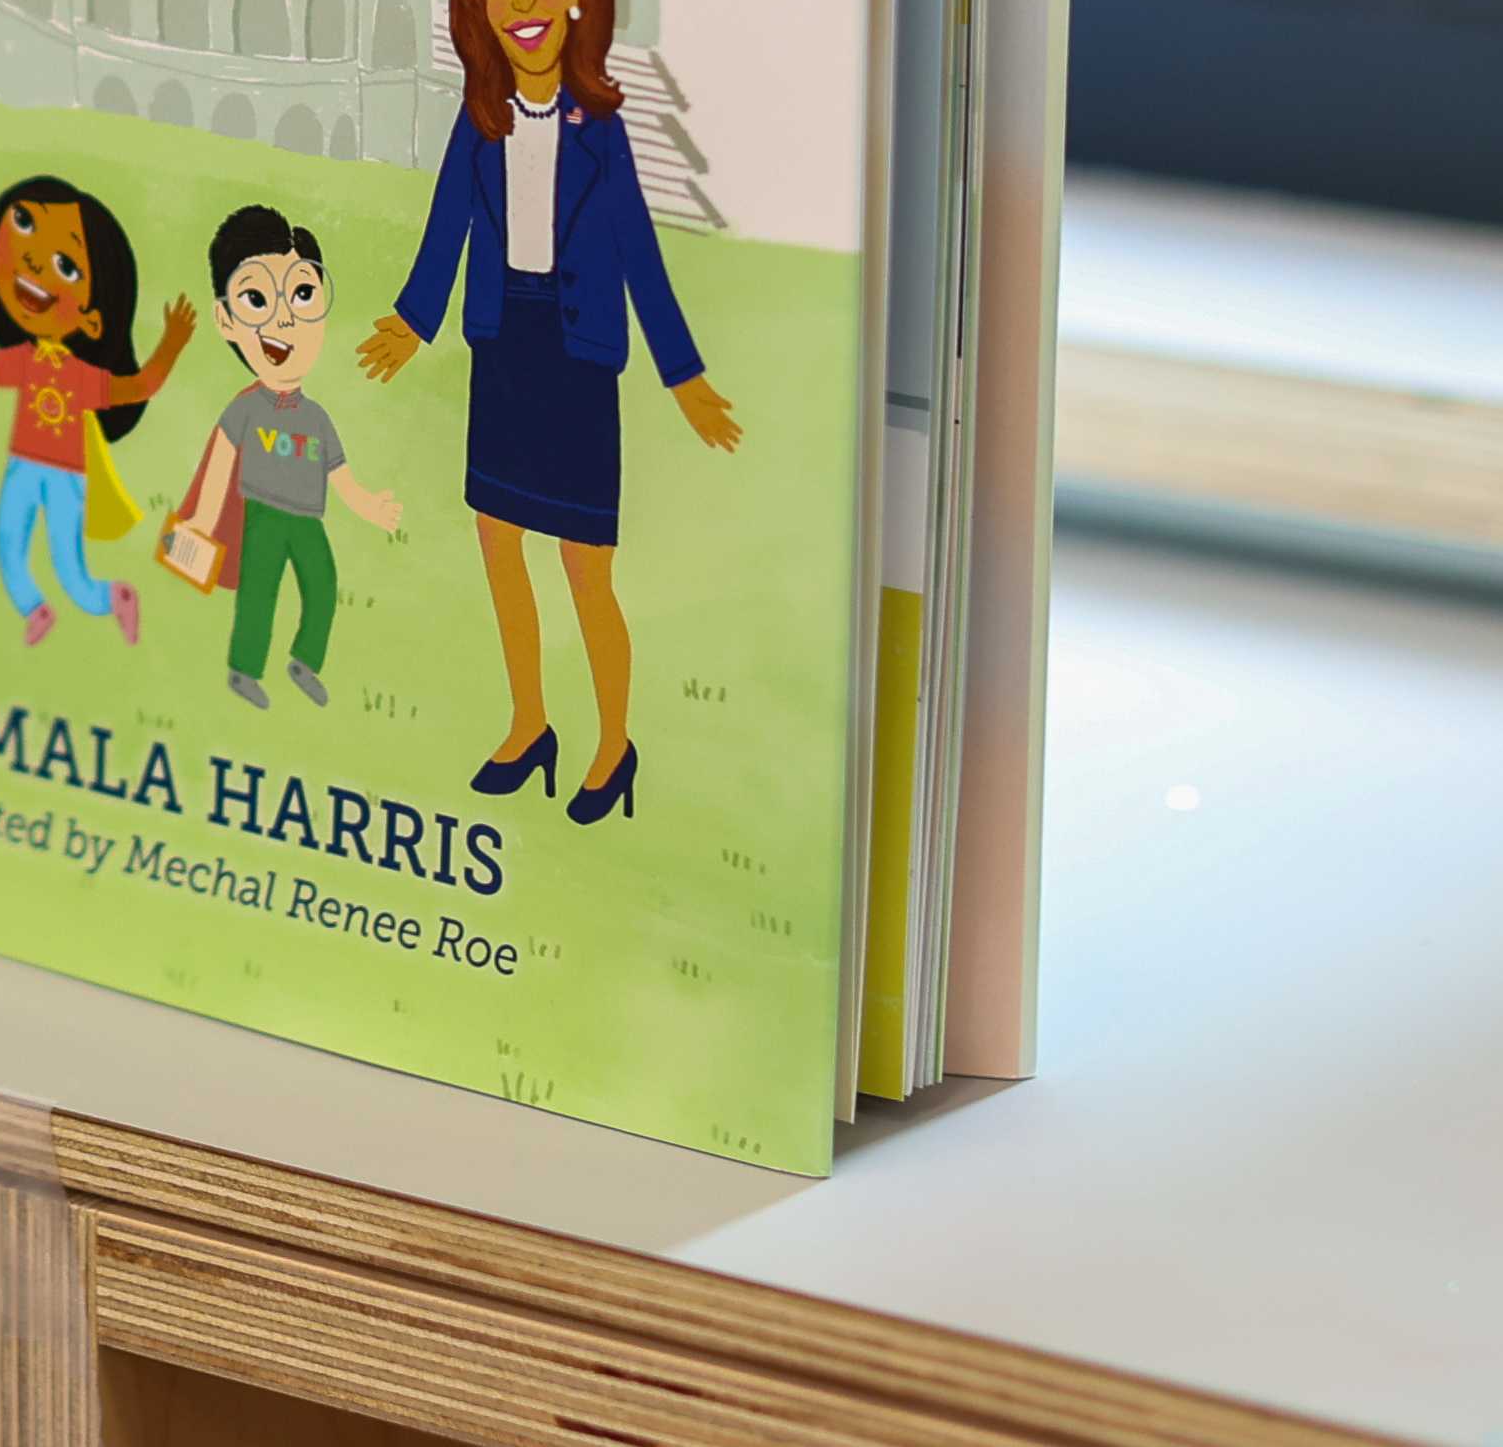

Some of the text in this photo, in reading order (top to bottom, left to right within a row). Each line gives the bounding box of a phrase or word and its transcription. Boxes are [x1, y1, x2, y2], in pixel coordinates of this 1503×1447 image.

[256, 426, 321, 462] VOTE
[63, 817, 116, 876] by
[122, 836, 276, 913] Mechal
[285, 878, 423, 951] Renee
[432, 916, 519, 977] Roe
[207, 755, 506, 897] HARRIS
